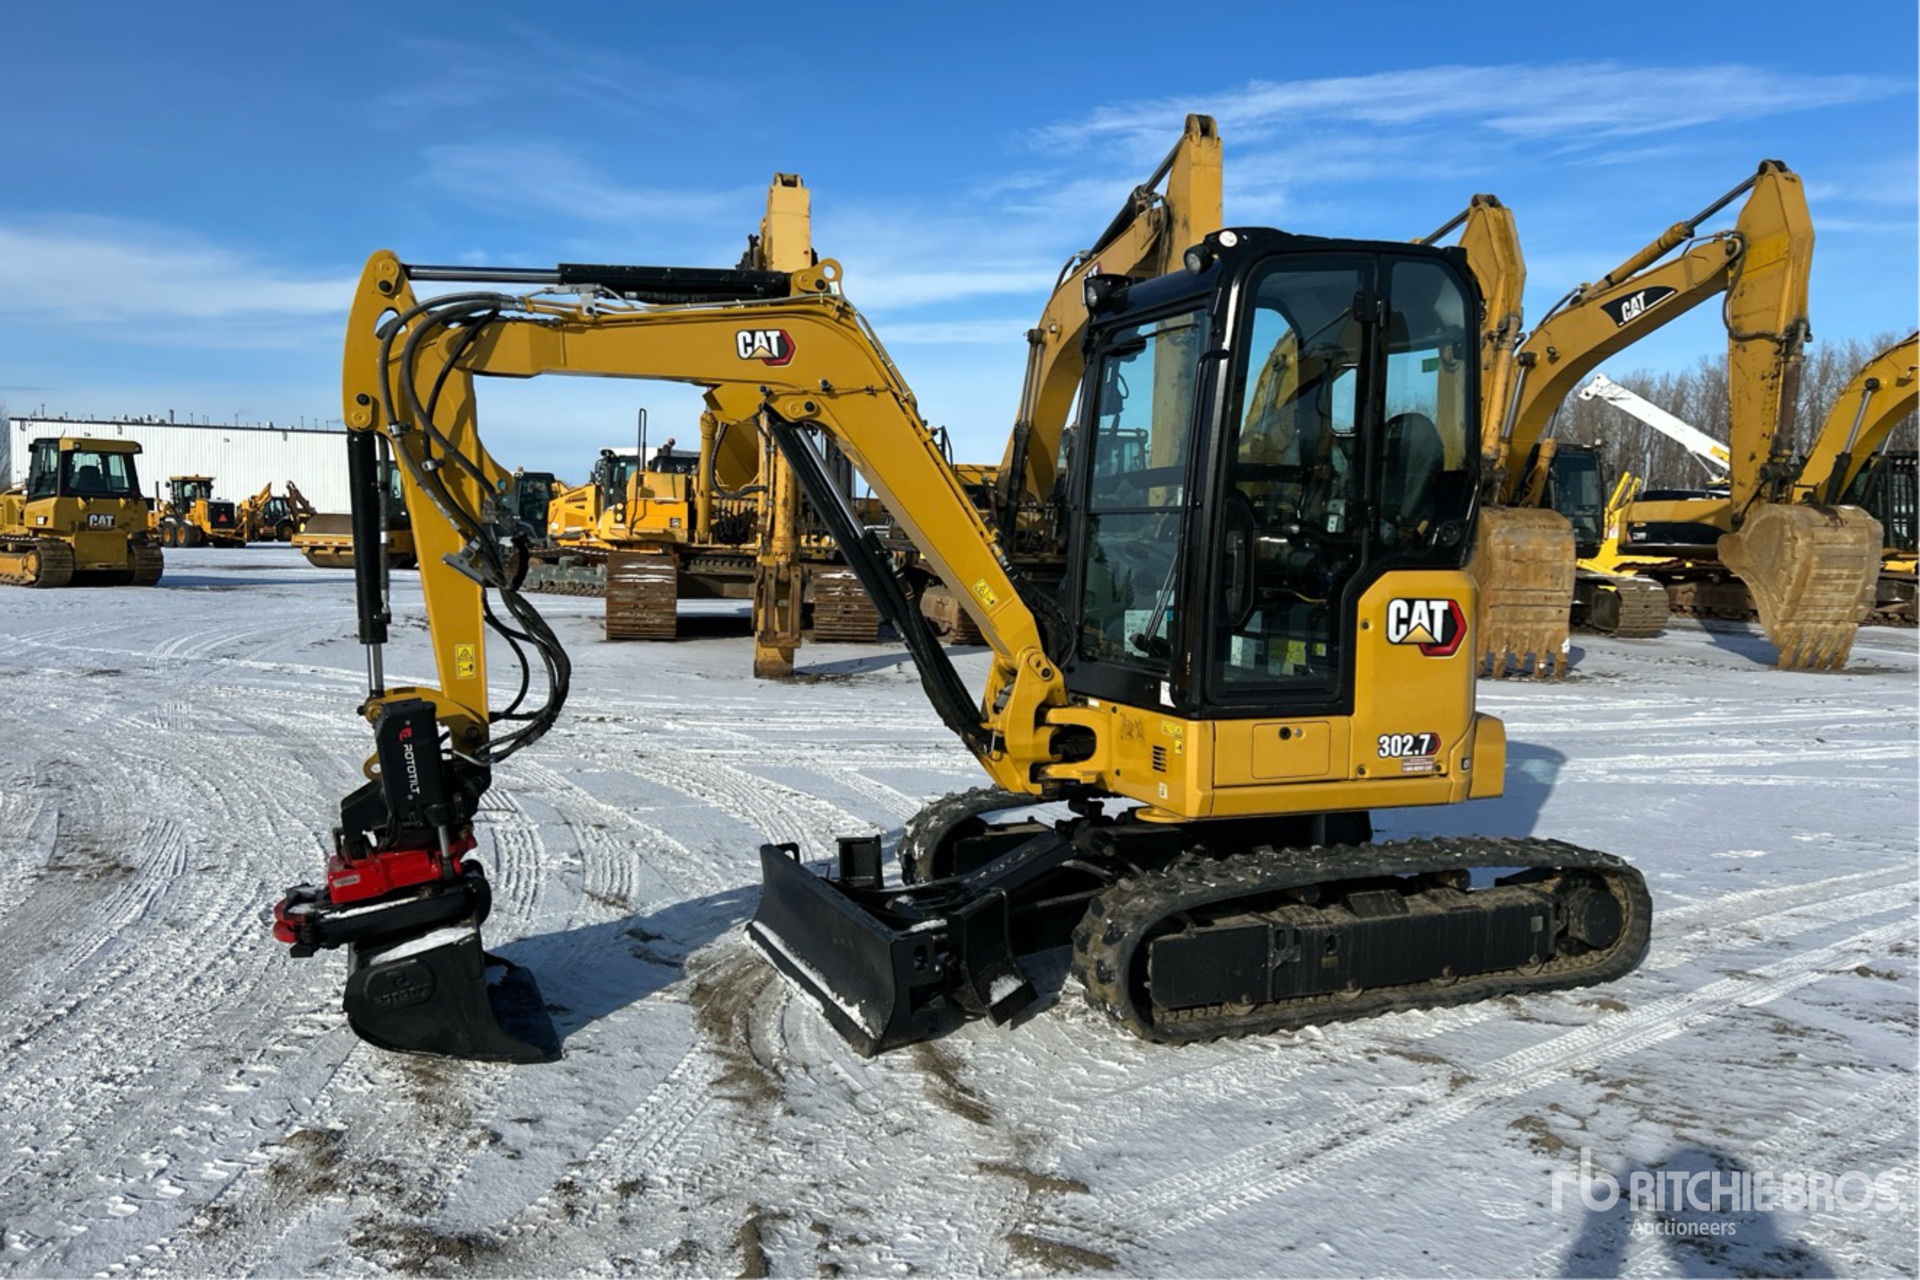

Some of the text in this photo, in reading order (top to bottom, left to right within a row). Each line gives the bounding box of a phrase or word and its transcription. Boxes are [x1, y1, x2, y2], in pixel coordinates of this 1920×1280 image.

[1620, 291, 1646, 322] CAT
[736, 330, 781, 359] CAT
[89, 514, 114, 529] CAT
[1387, 598, 1450, 644] CAT
[1378, 734, 1431, 757] 302.7
[402, 743, 420, 794] ROTOTILT
